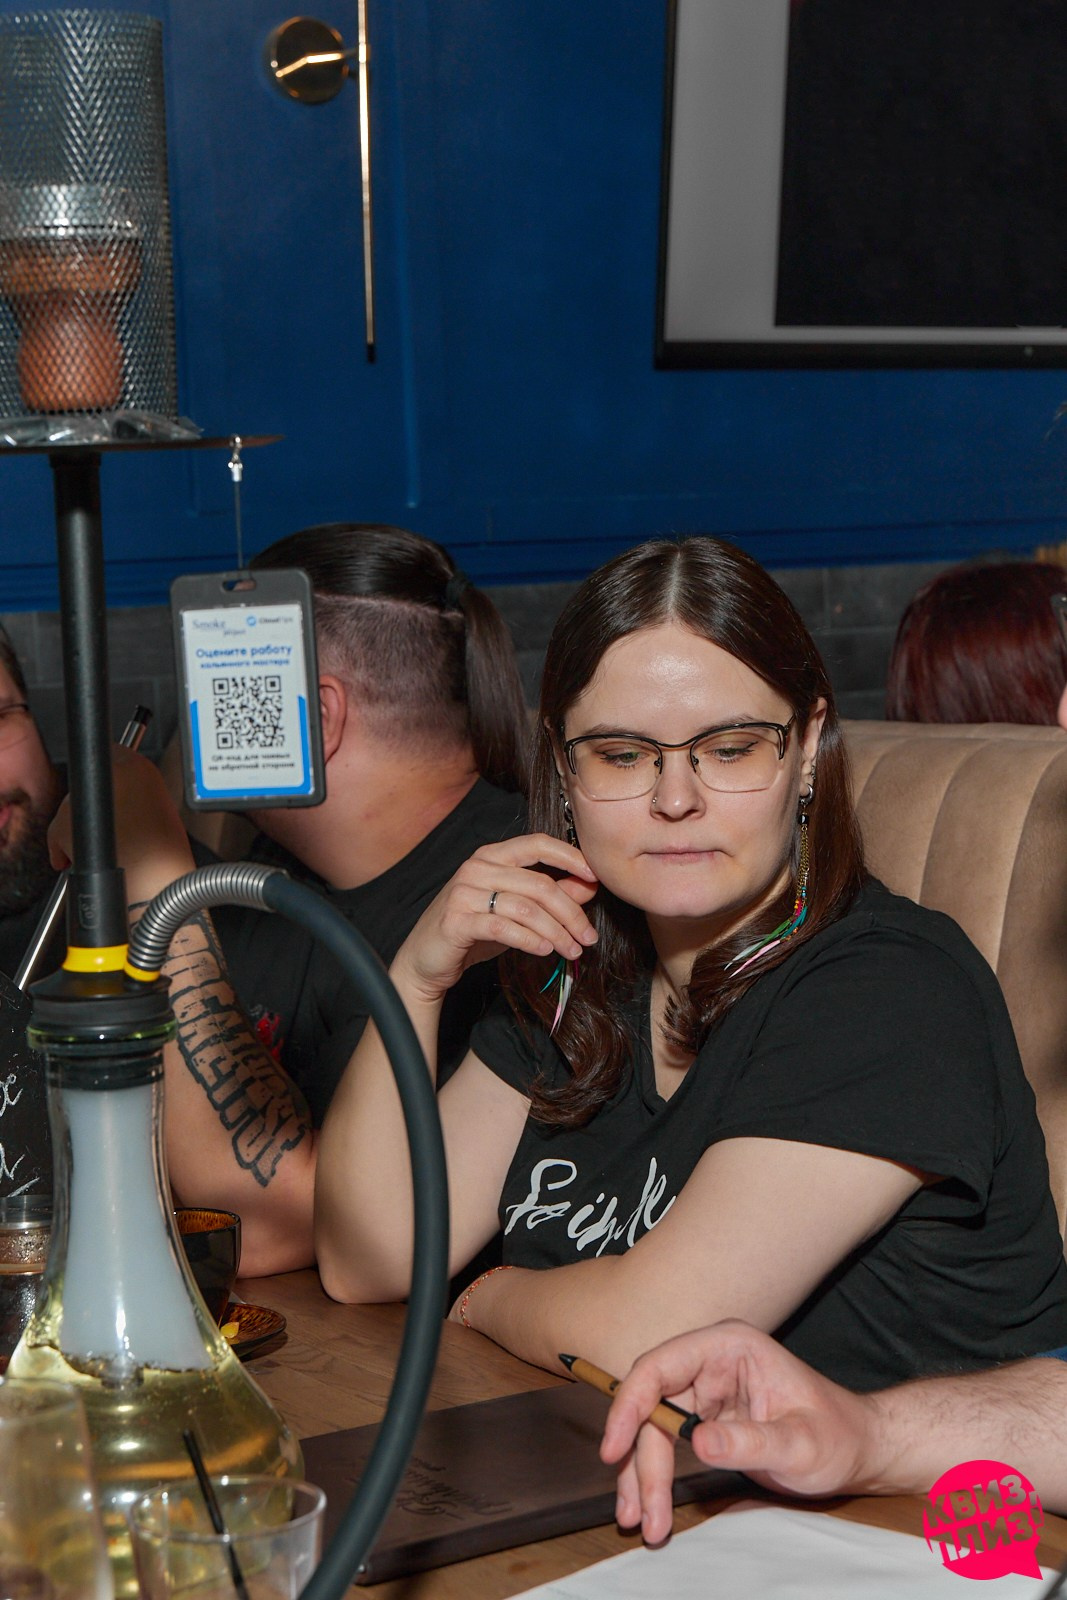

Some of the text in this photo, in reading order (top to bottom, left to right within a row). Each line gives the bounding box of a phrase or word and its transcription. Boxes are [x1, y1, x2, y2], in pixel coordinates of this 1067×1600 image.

[192, 619, 226, 630] Smoke
[196, 645, 292, 658] Оцените работу
[127, 897, 309, 1188] POCALYPSE
